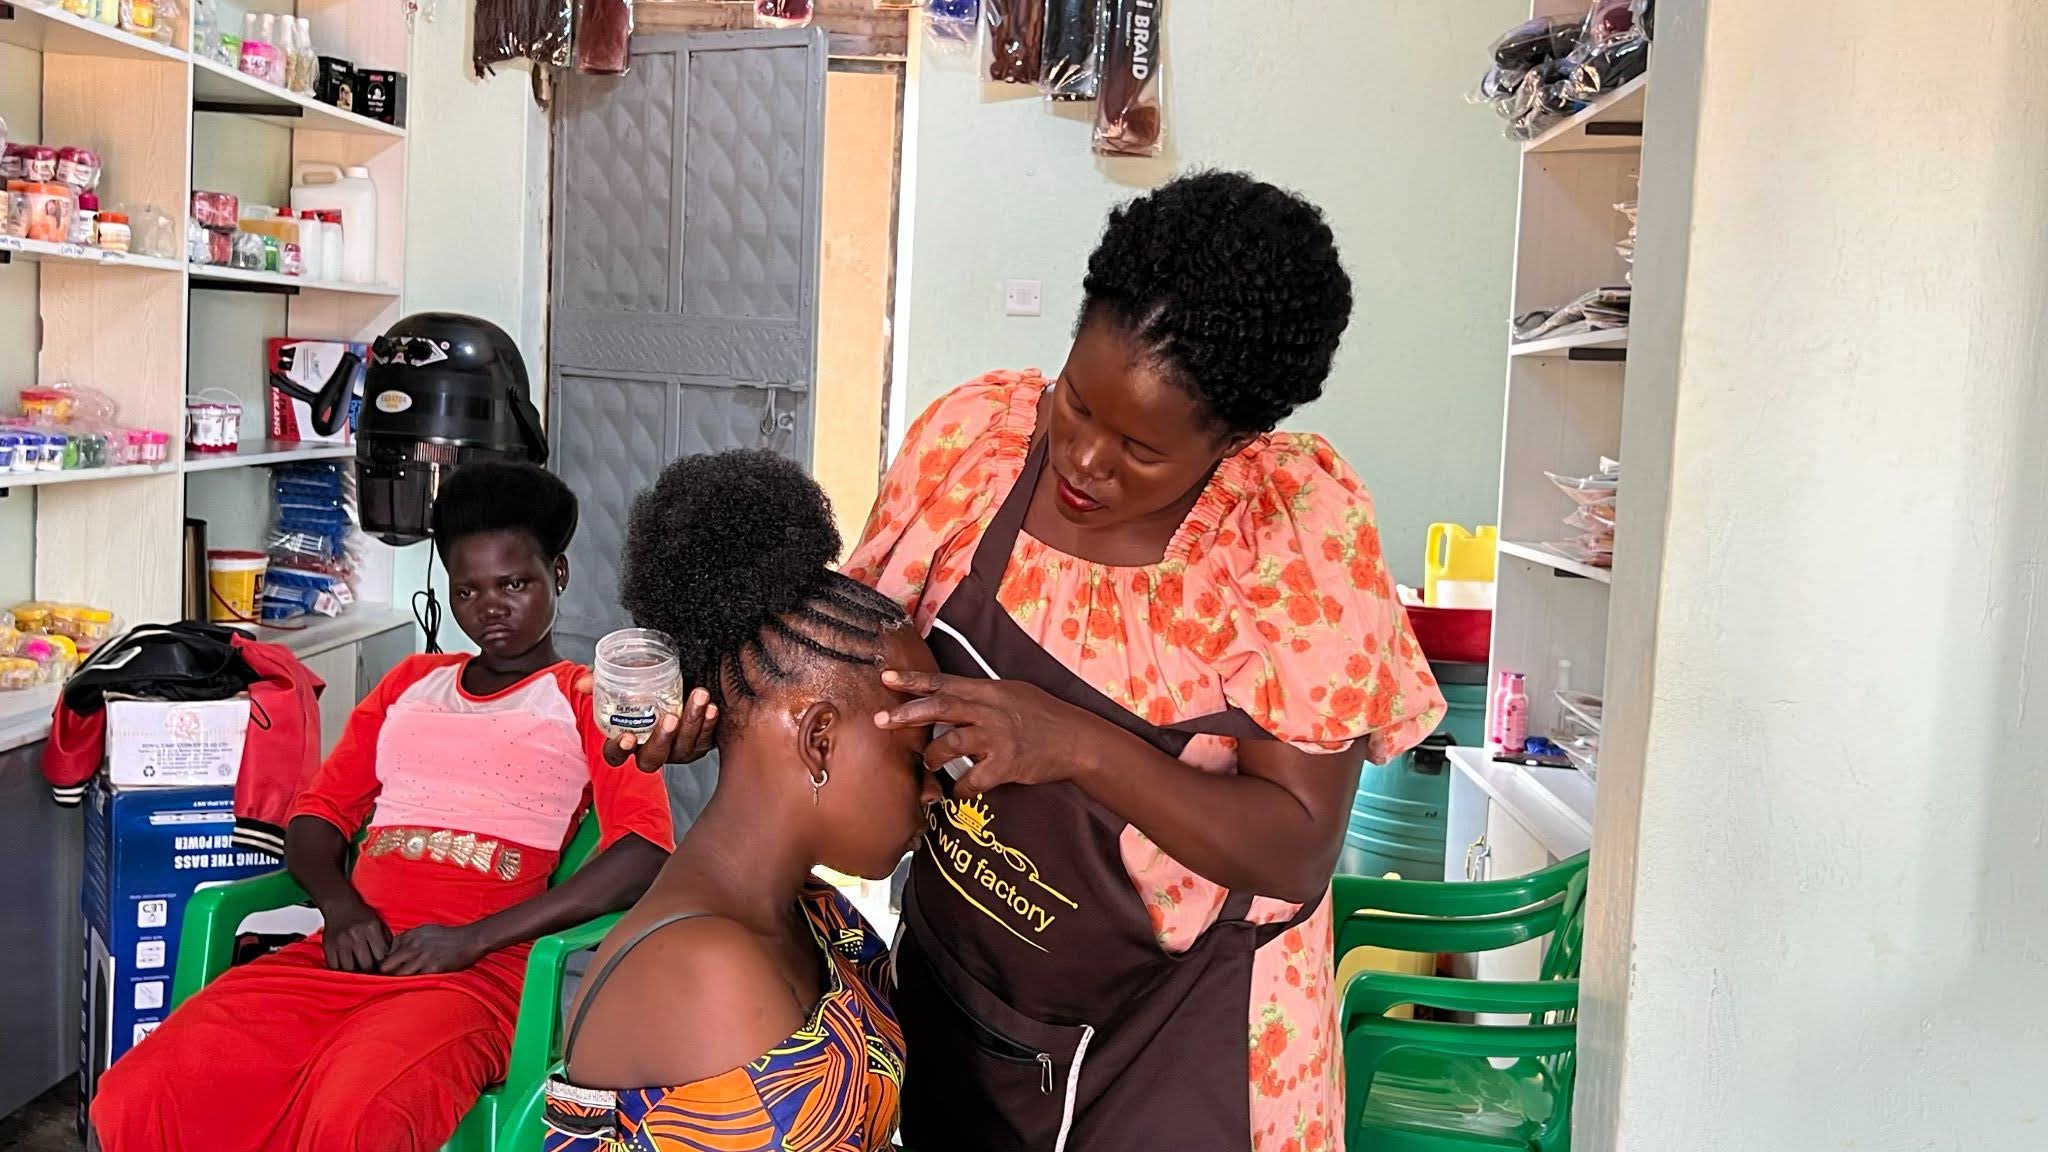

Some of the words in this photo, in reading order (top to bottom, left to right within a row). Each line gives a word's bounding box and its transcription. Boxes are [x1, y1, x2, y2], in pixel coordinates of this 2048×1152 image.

[1132, 14, 1150, 80] BRAID
[174, 835, 213, 851] POWER
[214, 835, 233, 849] IGH
[174, 854, 209, 870] BASS
[211, 853, 235, 868] THE
[939, 828, 973, 874] wig
[973, 859, 1055, 933] factory
[142, 903, 164, 914] LED
